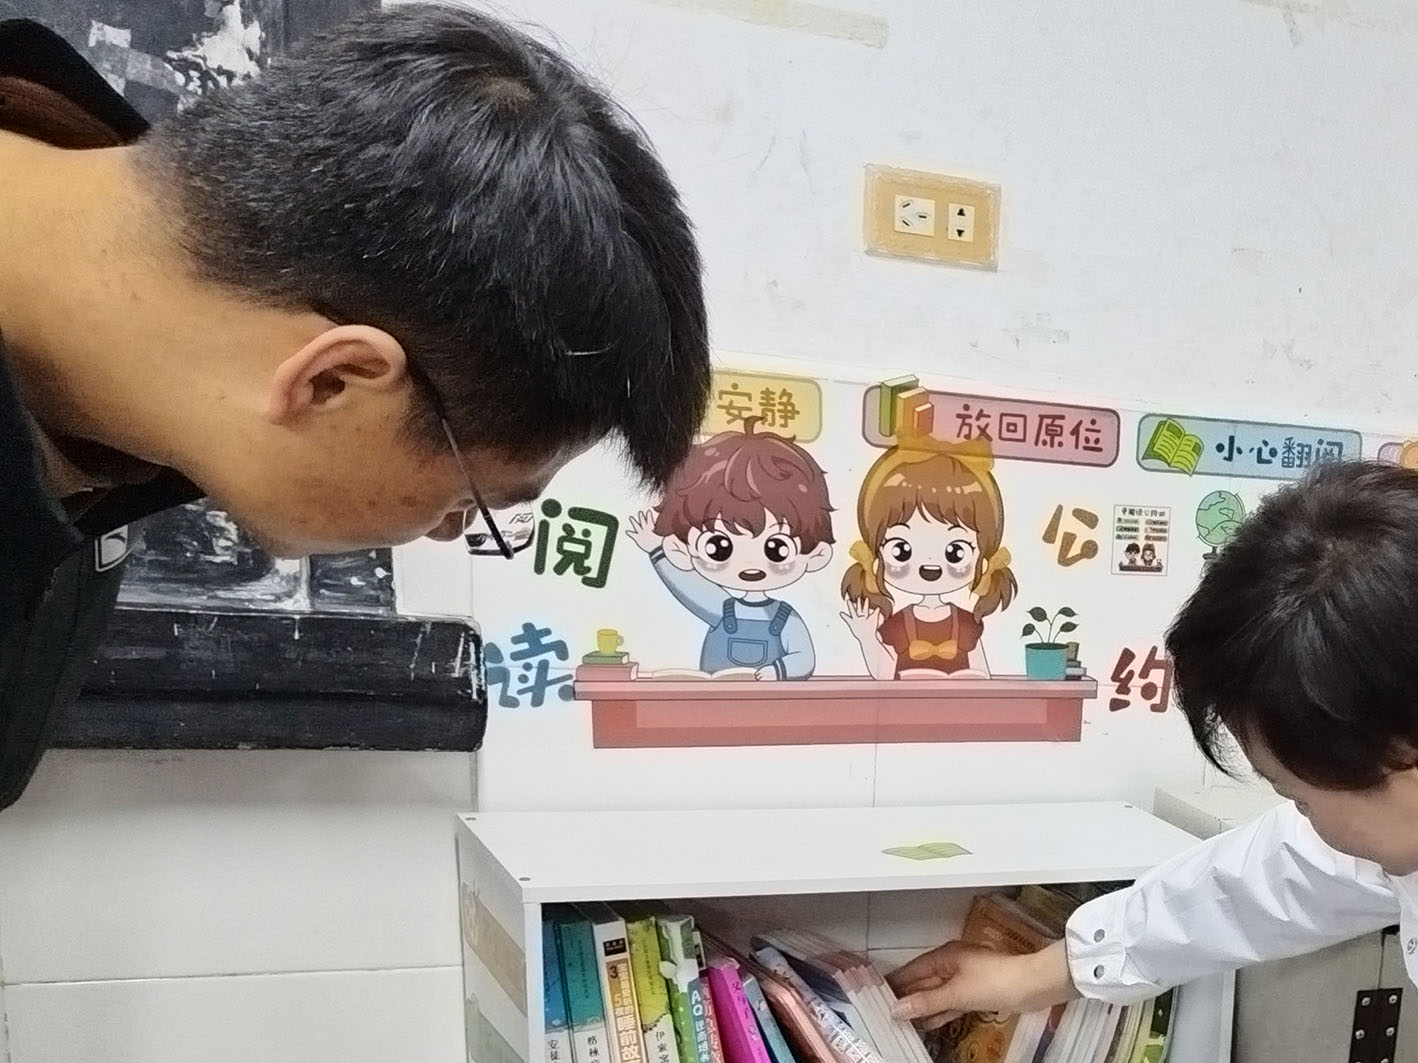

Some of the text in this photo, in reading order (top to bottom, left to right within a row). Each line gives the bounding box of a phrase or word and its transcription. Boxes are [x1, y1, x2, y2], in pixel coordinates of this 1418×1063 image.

[716, 382, 801, 429] 安静
[956, 403, 1104, 453] 放回原位
